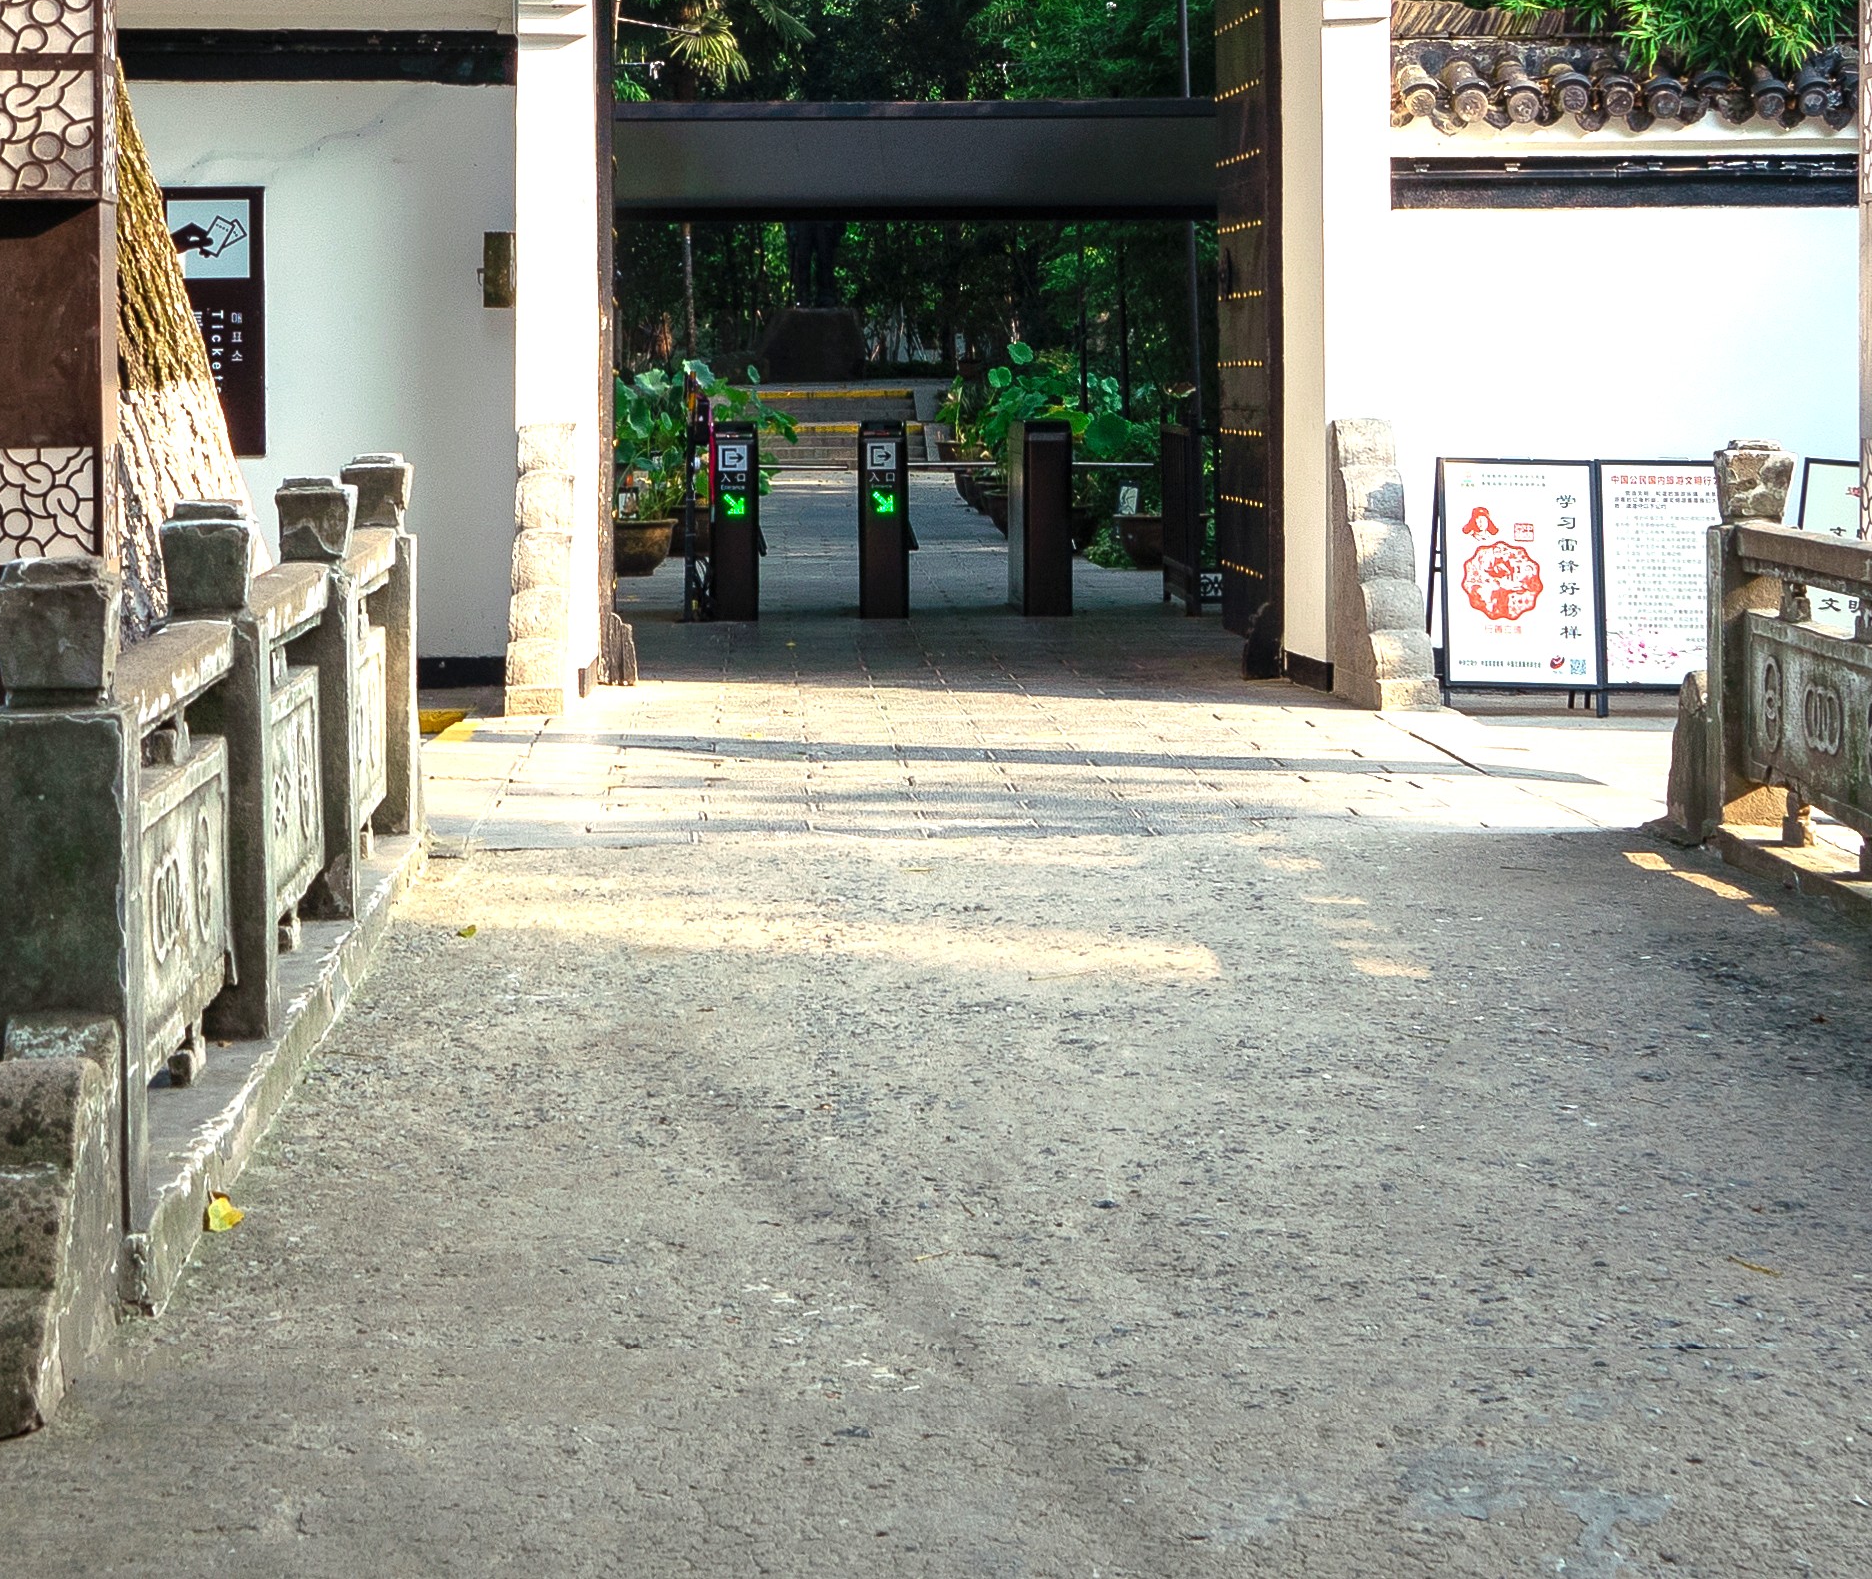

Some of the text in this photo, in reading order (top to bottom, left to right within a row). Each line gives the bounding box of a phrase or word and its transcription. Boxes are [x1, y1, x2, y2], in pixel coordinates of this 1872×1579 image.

[231, 312, 243, 361] 매표소
[721, 473, 745, 482] 入口
[869, 472, 895, 482] 入口
[1556, 494, 1582, 639] 学习雷锋好榜样
